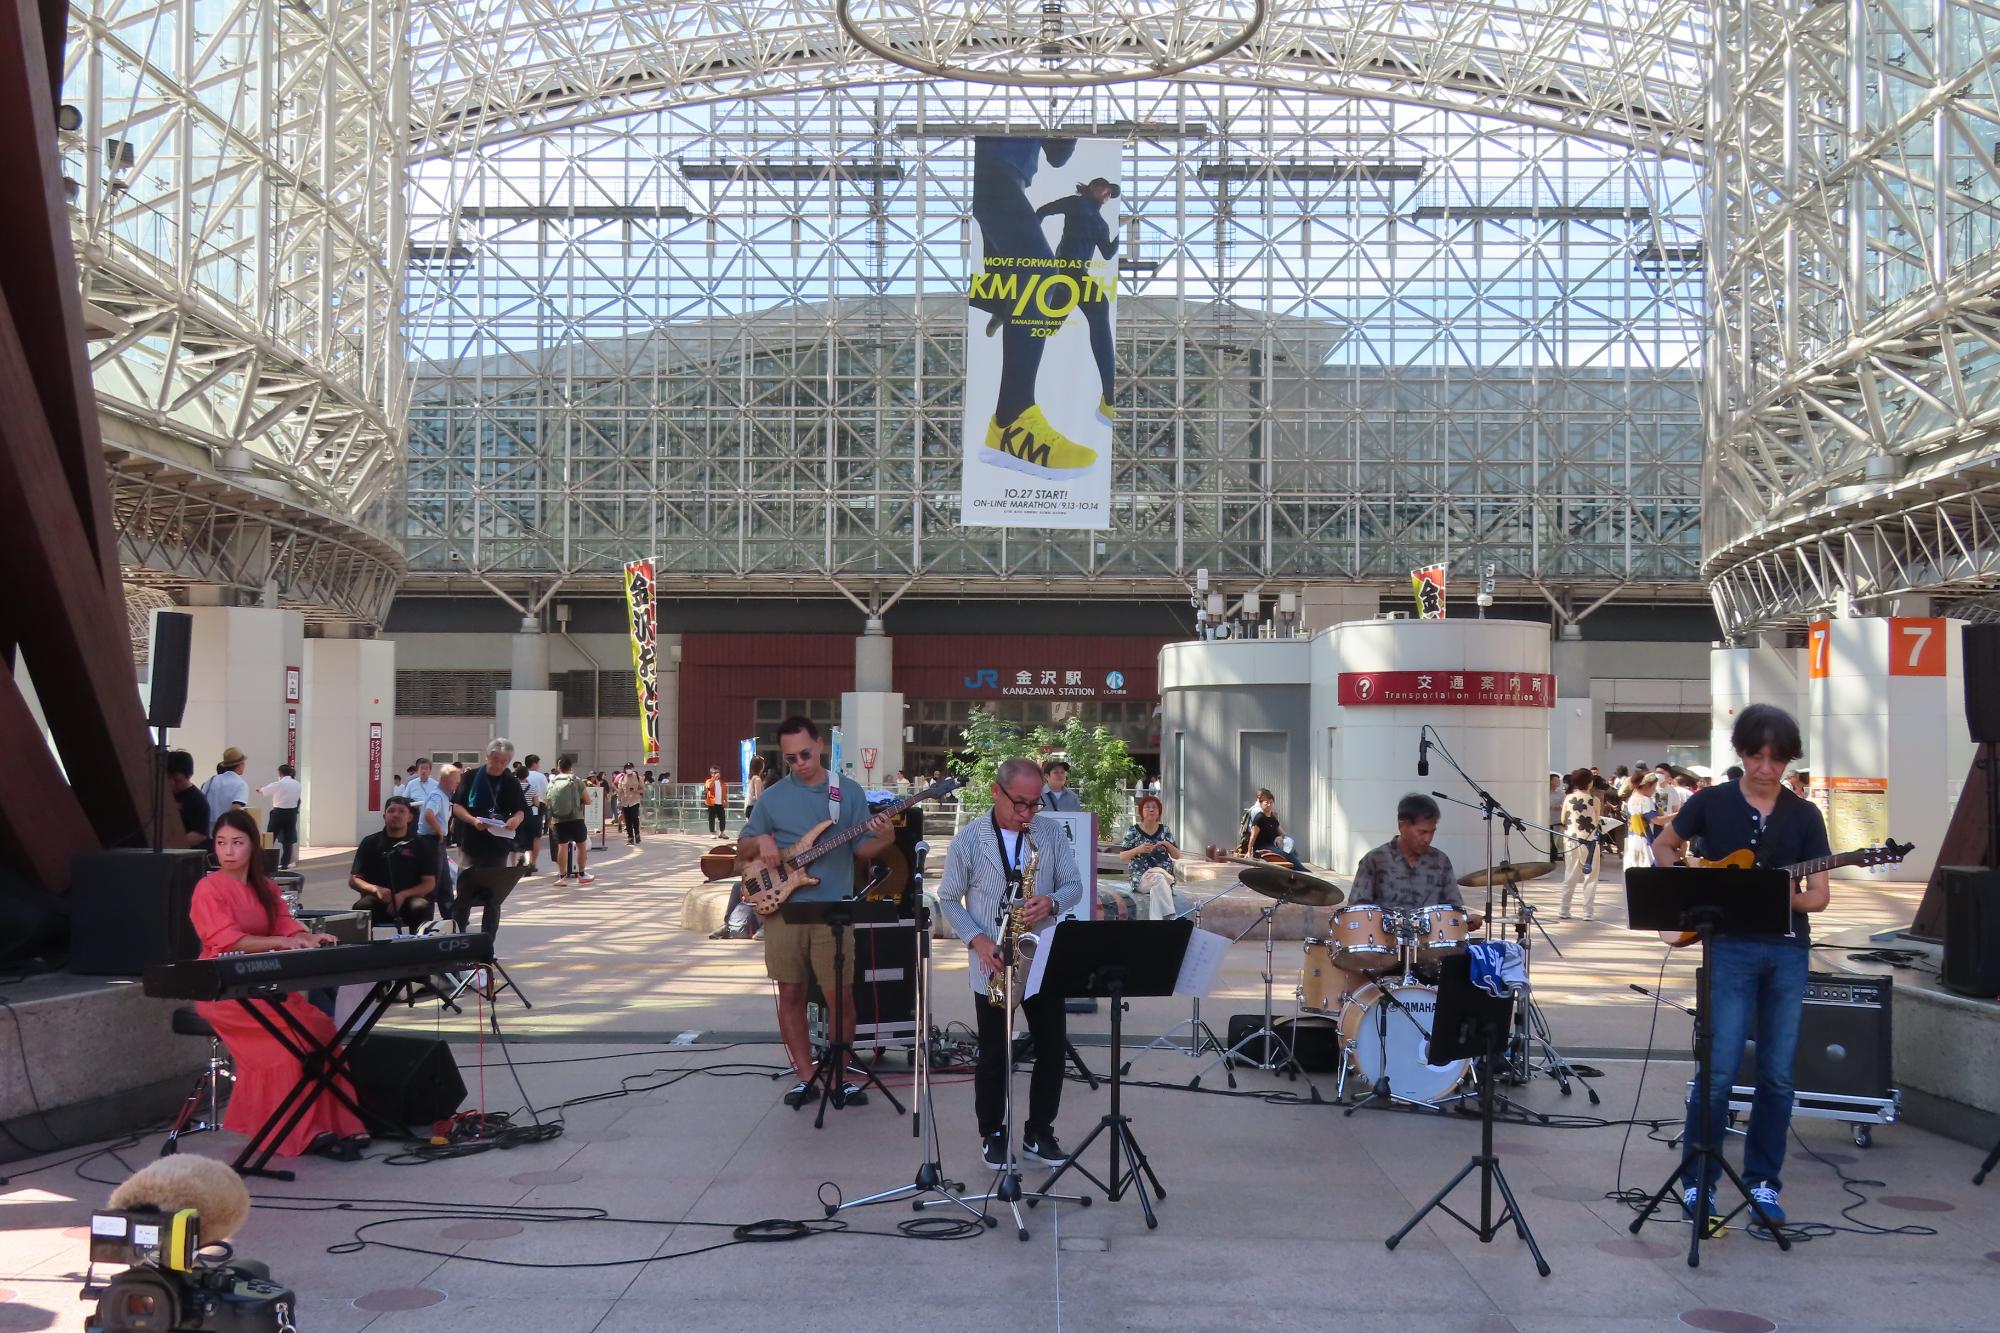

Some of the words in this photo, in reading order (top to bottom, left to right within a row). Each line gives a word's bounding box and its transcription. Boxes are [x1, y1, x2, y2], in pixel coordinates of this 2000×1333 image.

[984, 257, 1014, 267] MOVE
[1016, 257, 1067, 268] FORWARD
[1068, 259, 1081, 269] AS
[1030, 328, 1058, 338] 2024
[1000, 427, 1051, 467] KM
[1004, 488, 1033, 499] 10.27
[1034, 489, 1068, 500] START!
[973, 499, 1007, 508] ON-LINE
[1814, 630, 1825, 669] 7
[1903, 627, 1932, 667] 7
[963, 668, 999, 689] JR
[1015, 670, 1083, 686] 金沢駅
[1417, 675, 1542, 693] 交通案内所
[1002, 687, 1056, 696] KANAZAWA
[1058, 687, 1095, 696] STATION
[1478, 692, 1534, 701] Information
[439, 938, 471, 951] CP5
[244, 958, 282, 973] YAMAHA
